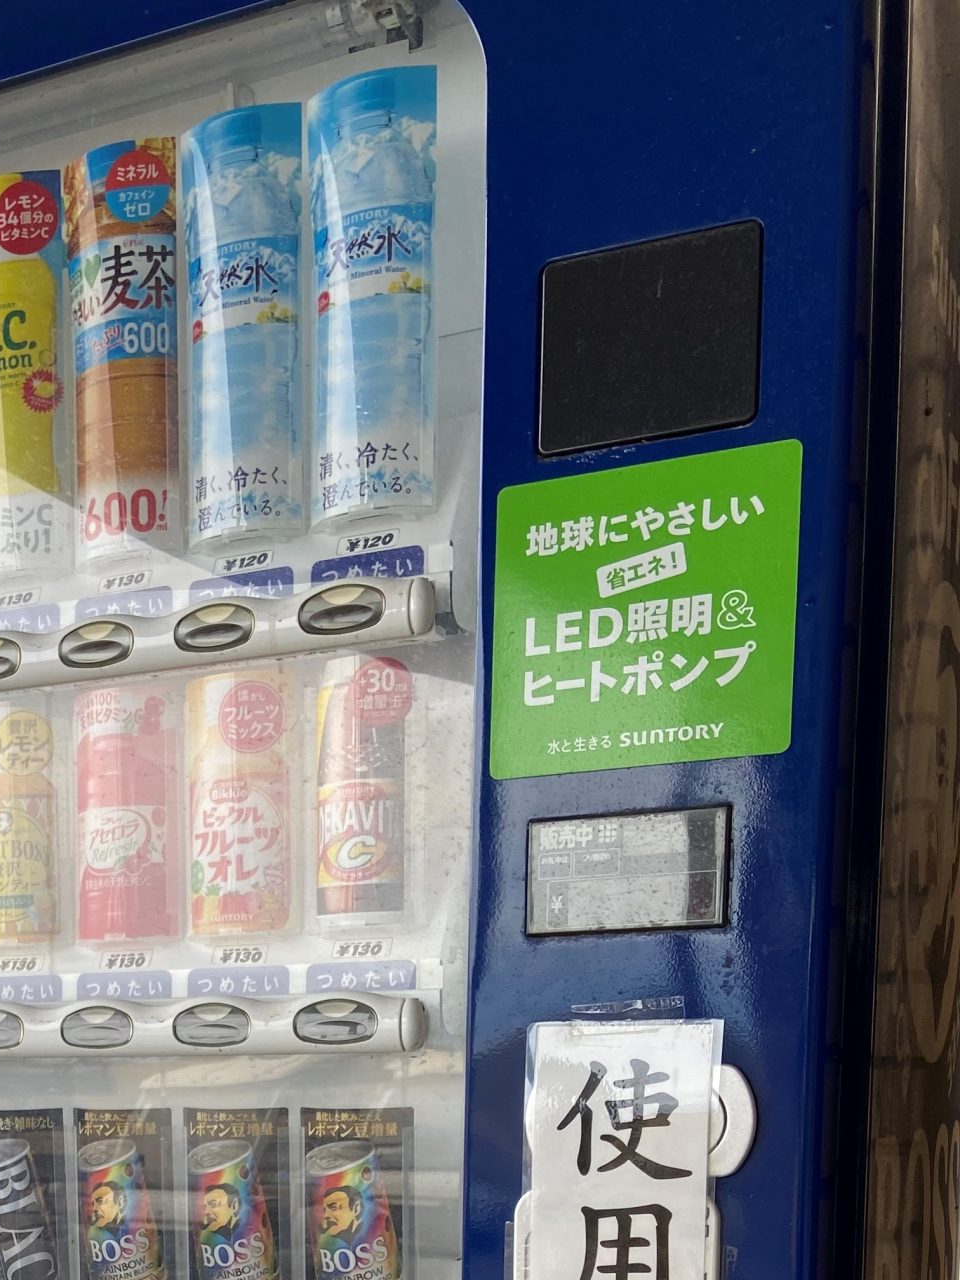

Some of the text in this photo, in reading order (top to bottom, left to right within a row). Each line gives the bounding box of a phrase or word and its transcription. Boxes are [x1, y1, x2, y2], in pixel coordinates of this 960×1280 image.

[116, 164, 158, 182] ミネラル
[5, 195, 45, 211] レモン
[118, 190, 155, 202] カフェイン
[123, 204, 151, 218] ゼロ
[0, 226, 50, 242] ビタミンC
[326, 225, 412, 279] 天然水
[101, 244, 175, 314] 麦茶
[199, 257, 279, 306] 天然水
[123, 322, 170, 354] 600
[320, 441, 419, 481] 清く、冷たく、
[195, 466, 288, 503] 清く、冷たく、
[323, 475, 411, 511] 澄んでいる。
[198, 499, 281, 533] 澄んでいる。
[526, 495, 765, 557] 地球にやさしい
[346, 533, 394, 552] ¥120
[223, 553, 268, 571] ¥120
[605, 552, 678, 590] 省エネ!
[103, 573, 145, 589] ¥130
[524, 589, 757, 657] LED照明&
[524, 640, 757, 707] ヒートポンプ
[224, 703, 281, 723] フルーツ
[0, 735, 49, 752] レモン
[227, 721, 277, 740] ミックス
[547, 722, 724, 755] 水と生きる SUNTORY
[7, 753, 45, 769] ティー
[202, 805, 265, 829] ビックル
[89, 820, 141, 849] アセロラ
[194, 825, 283, 858] フルーツ
[206, 853, 259, 885] オレ
[106, 954, 146, 969] ¥130
[220, 949, 263, 963] ¥130
[337, 942, 383, 957] ¥130
[86, 981, 163, 997] つめたい
[198, 977, 279, 993] つめたい
[317, 971, 405, 988] つめたい
[90, 1228, 150, 1263] BOSS
[200, 1232, 265, 1268] BOSS
[320, 1236, 388, 1273] BOSS
